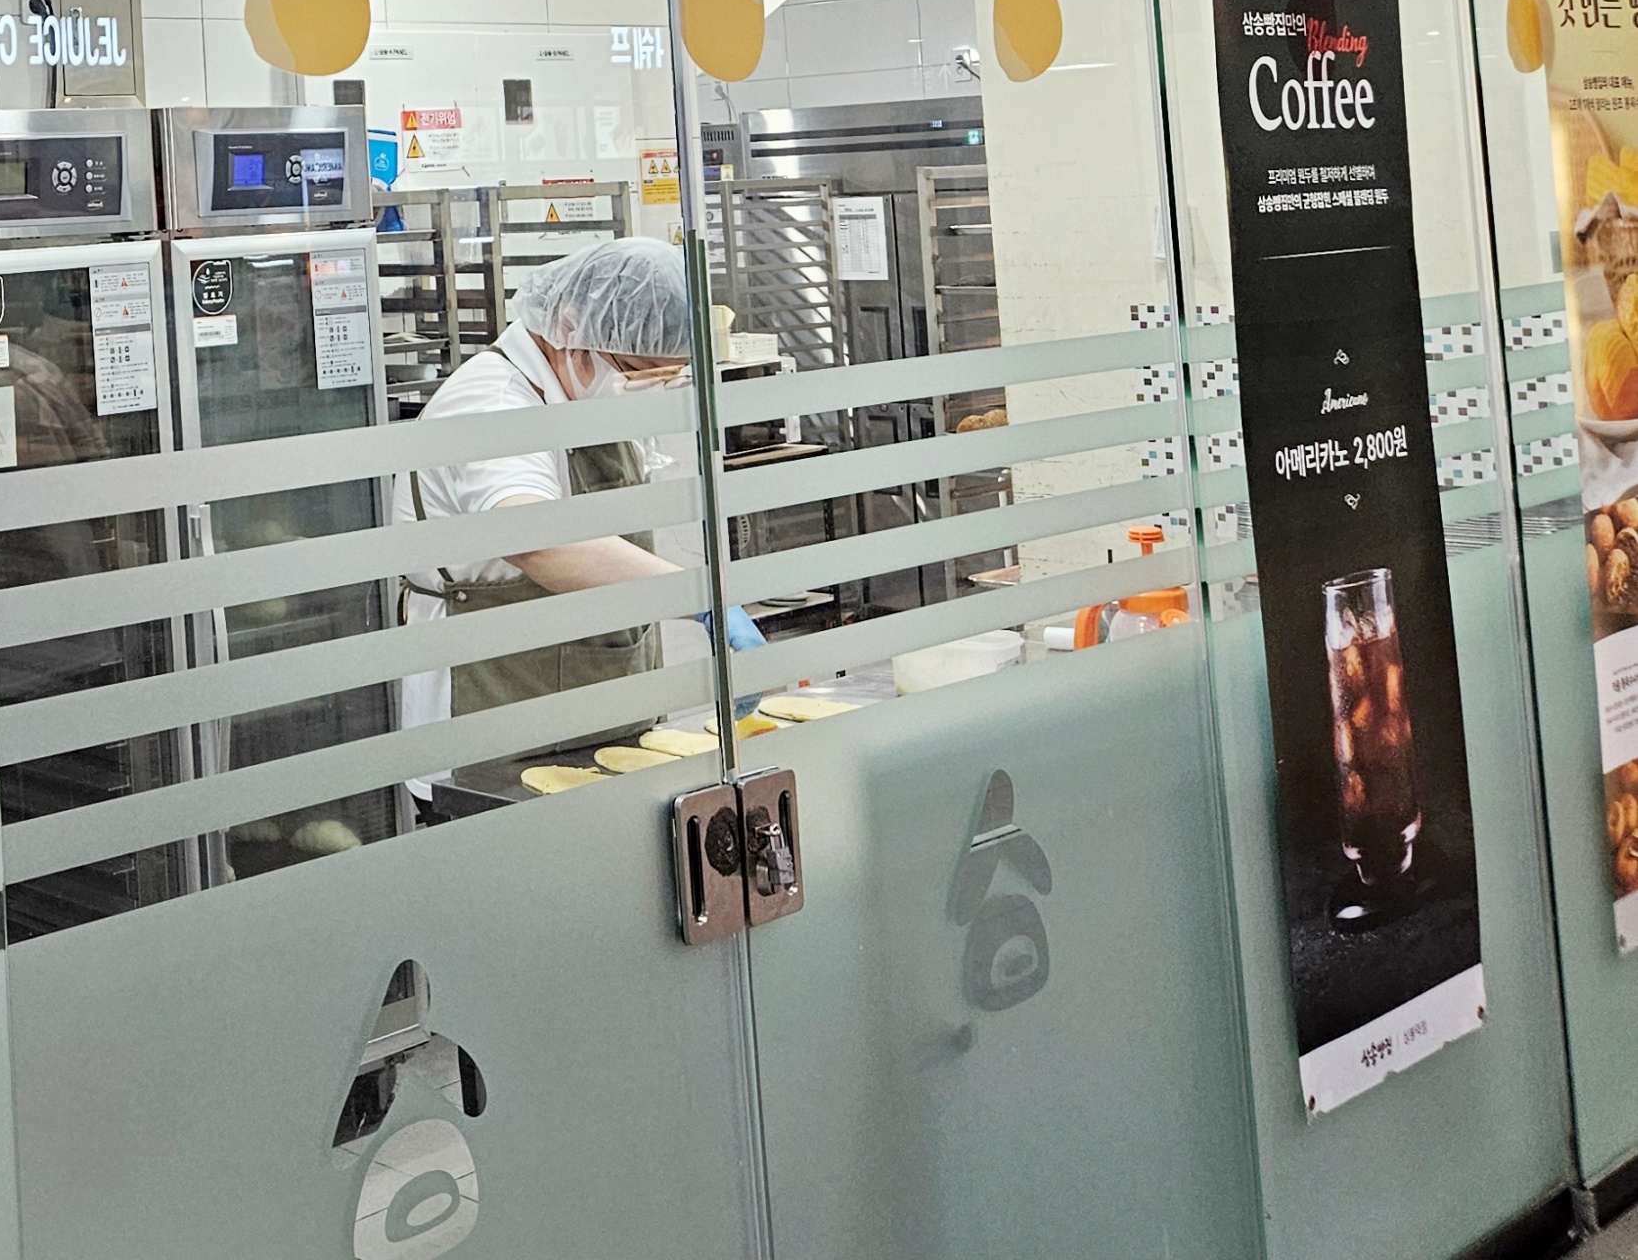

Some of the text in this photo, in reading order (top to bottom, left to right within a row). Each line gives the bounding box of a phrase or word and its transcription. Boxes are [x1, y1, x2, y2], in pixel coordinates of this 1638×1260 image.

[1242, 11, 1307, 36] 삼송빵집만의
[1306, 17, 1369, 68] Blending
[1248, 49, 1376, 132] Coffee
[421, 111, 457, 126] 전기위험
[1267, 168, 1297, 185] 프리미엄
[1297, 166, 1319, 184] 원두를
[1257, 193, 1303, 213] 삼송빵집만의
[1332, 189, 1354, 207] 스페셜
[1353, 188, 1374, 207] 블렌딩
[1374, 187, 1389, 204] 원두
[1275, 424, 1408, 480] 아메리카노 2,800원
